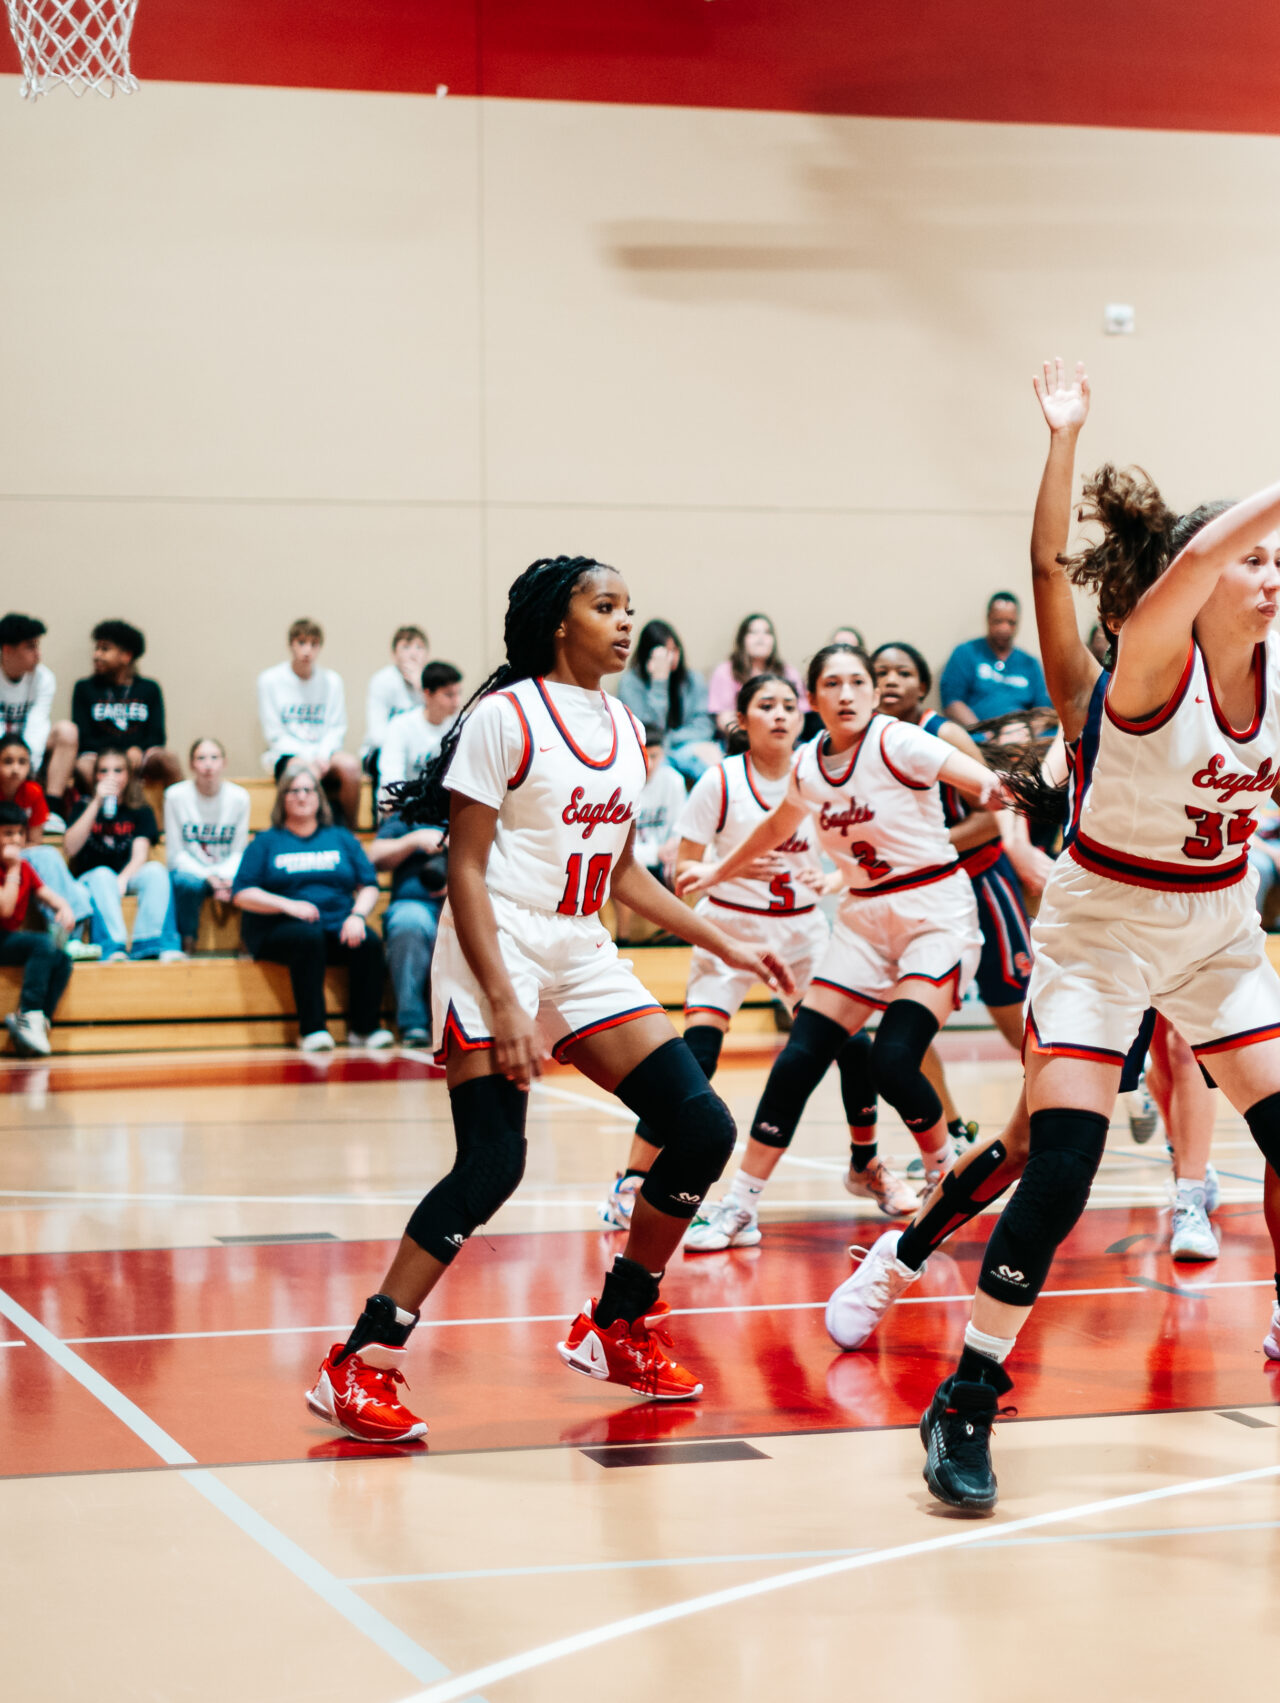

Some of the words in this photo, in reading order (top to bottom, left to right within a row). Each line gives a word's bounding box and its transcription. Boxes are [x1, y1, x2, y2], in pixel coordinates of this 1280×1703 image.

[92, 702, 149, 721] EAGLES
[562, 783, 633, 839] Eagles
[820, 796, 875, 837] Eagles
[850, 840, 893, 881] 2
[556, 852, 613, 917] 10
[769, 870, 795, 911] 5
